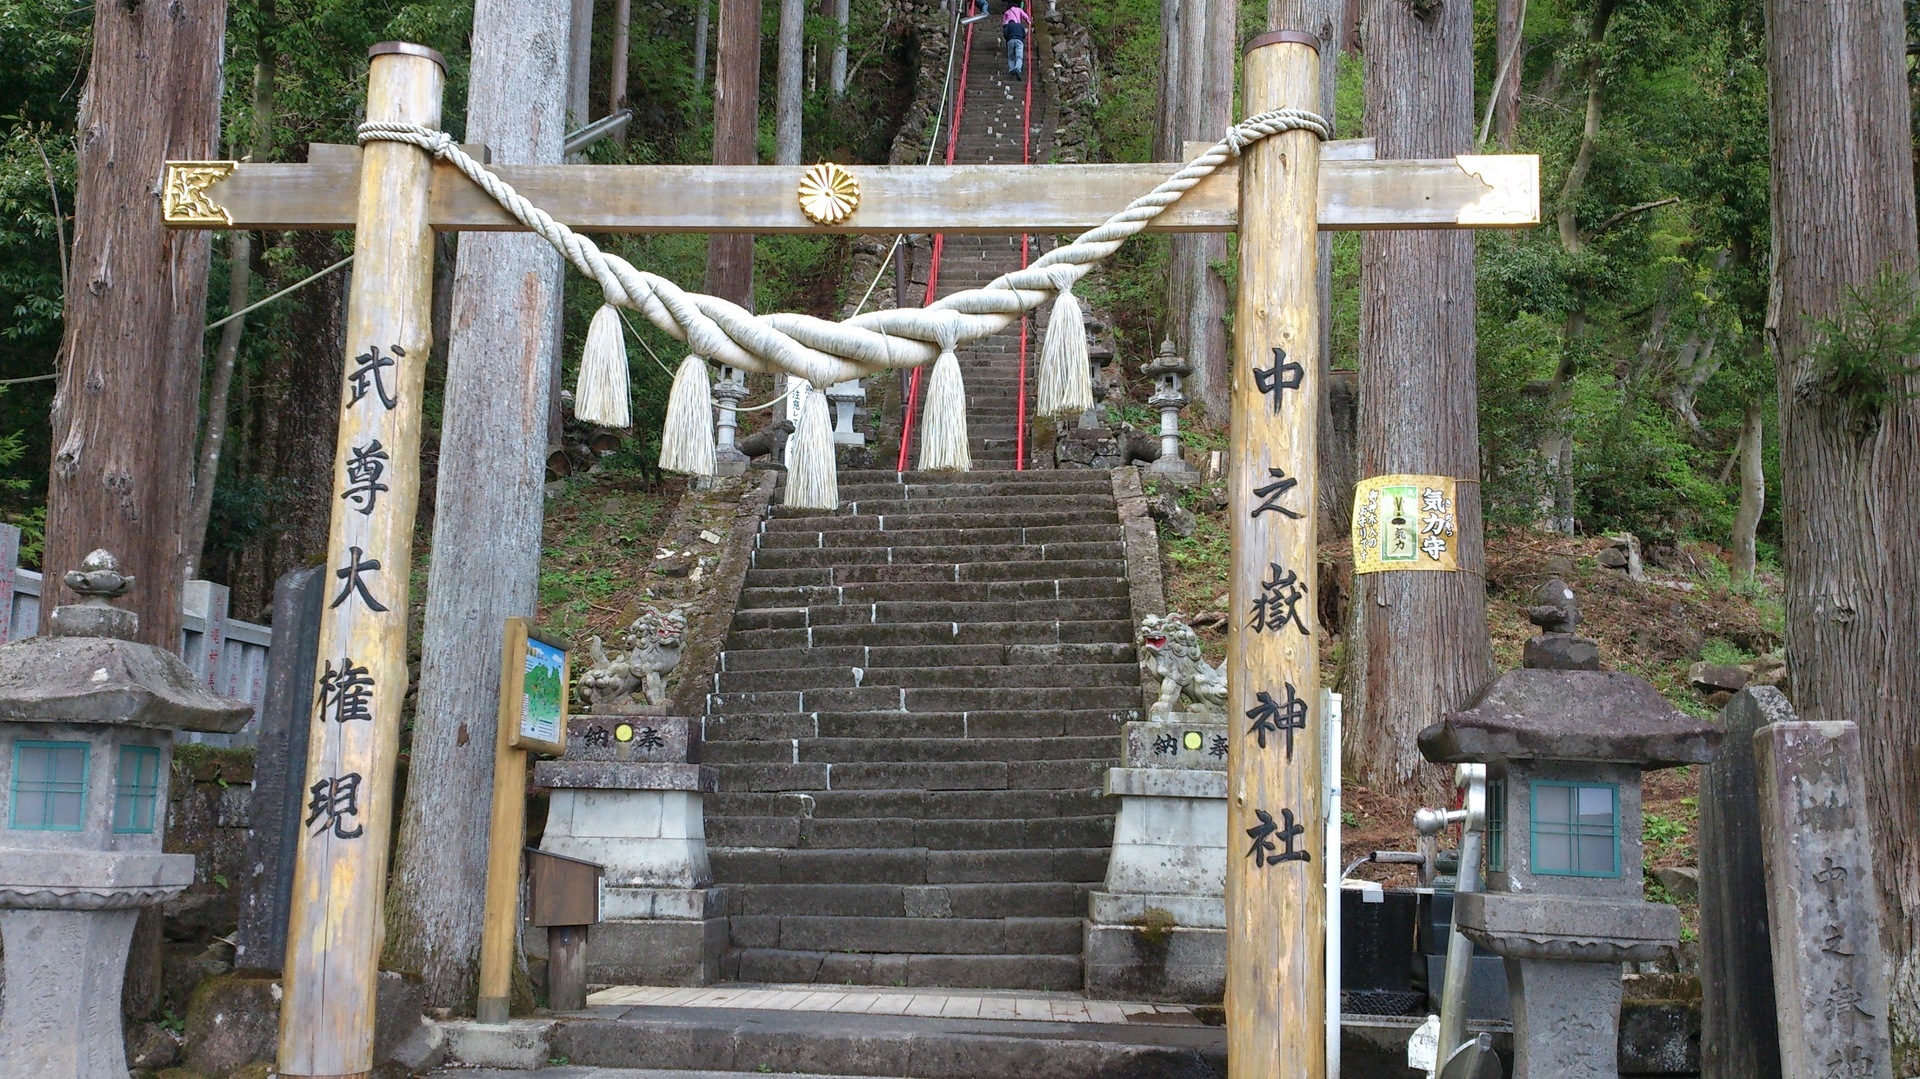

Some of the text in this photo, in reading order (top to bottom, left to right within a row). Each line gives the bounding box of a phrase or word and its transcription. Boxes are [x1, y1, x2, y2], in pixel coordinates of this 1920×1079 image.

[304, 343, 406, 840] 武尊大権現
[1244, 346, 1311, 868] 中之嶽神社
[1392, 527, 1408, 554] 気力
[1421, 487, 1447, 562] 気力守
